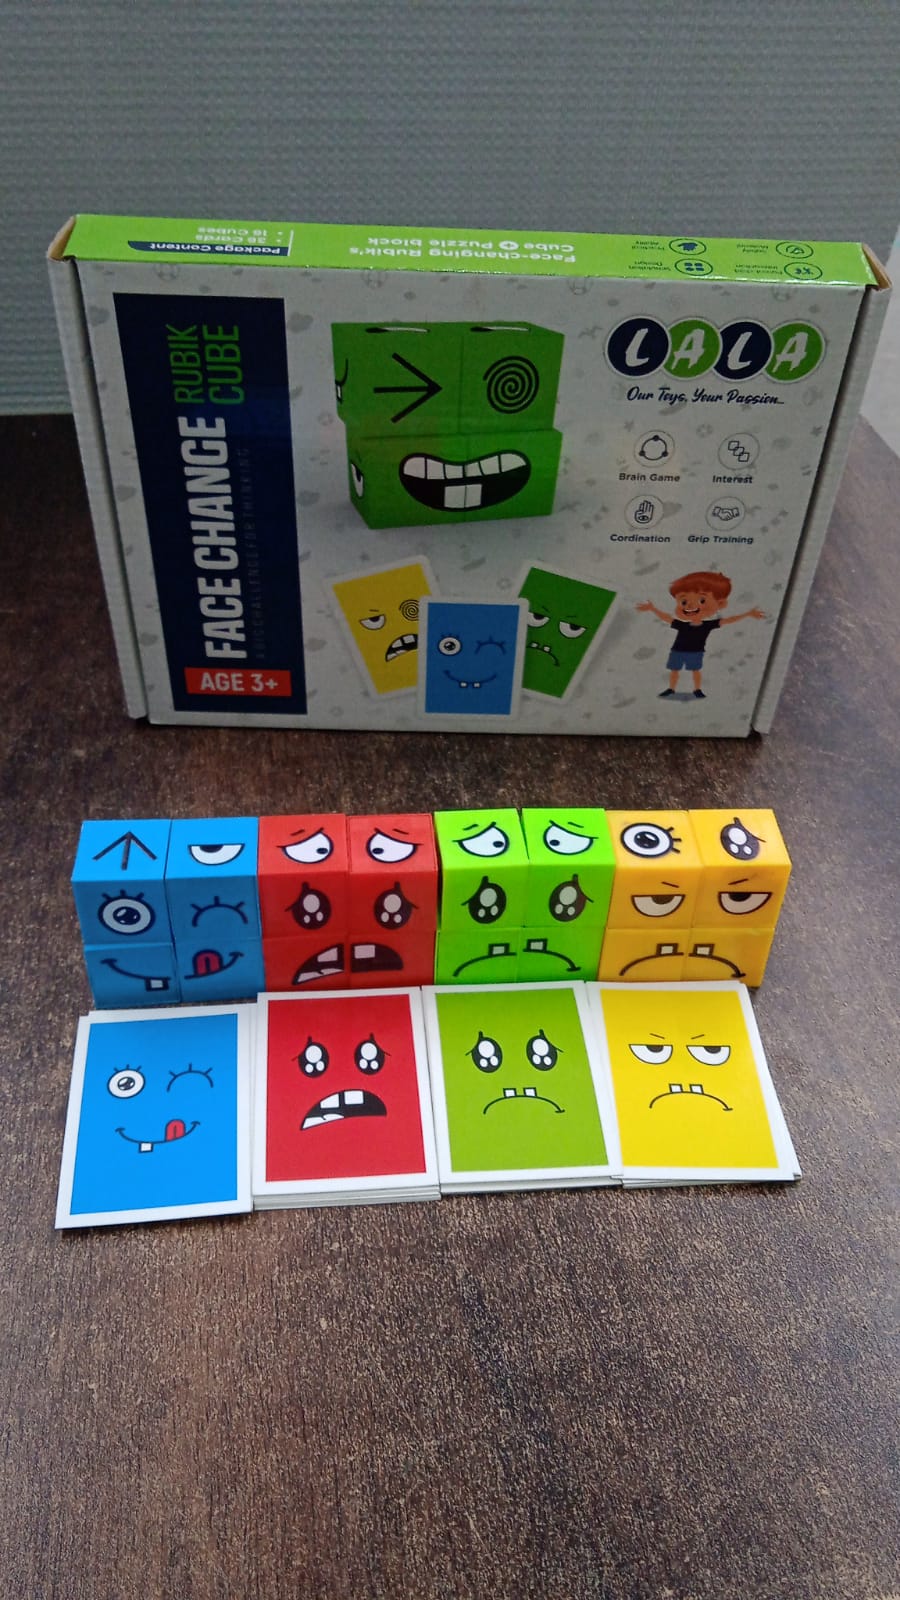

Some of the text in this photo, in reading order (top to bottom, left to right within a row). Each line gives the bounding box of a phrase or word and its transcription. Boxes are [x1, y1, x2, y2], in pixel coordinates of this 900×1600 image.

[195, 234, 243, 243] Cards
[198, 227, 248, 236] Cubes
[150, 243, 280, 254] Package Content
[368, 237, 574, 252] Cube Puzzle block
[347, 247, 576, 263] Face-changing Rubik's
[623, 326, 810, 375] LALA
[165, 324, 205, 404] RUBIK
[202, 325, 245, 405] CUBE
[627, 386, 654, 401] Our
[693, 389, 723, 403] Your
[619, 472, 681, 482] Brain Game
[712, 475, 753, 484] Interest
[177, 416, 248, 659] FACE CHANGE
[610, 533, 671, 543] Cordination
[687, 535, 754, 545] Grip Training
[200, 672, 278, 692] AGE 3+
